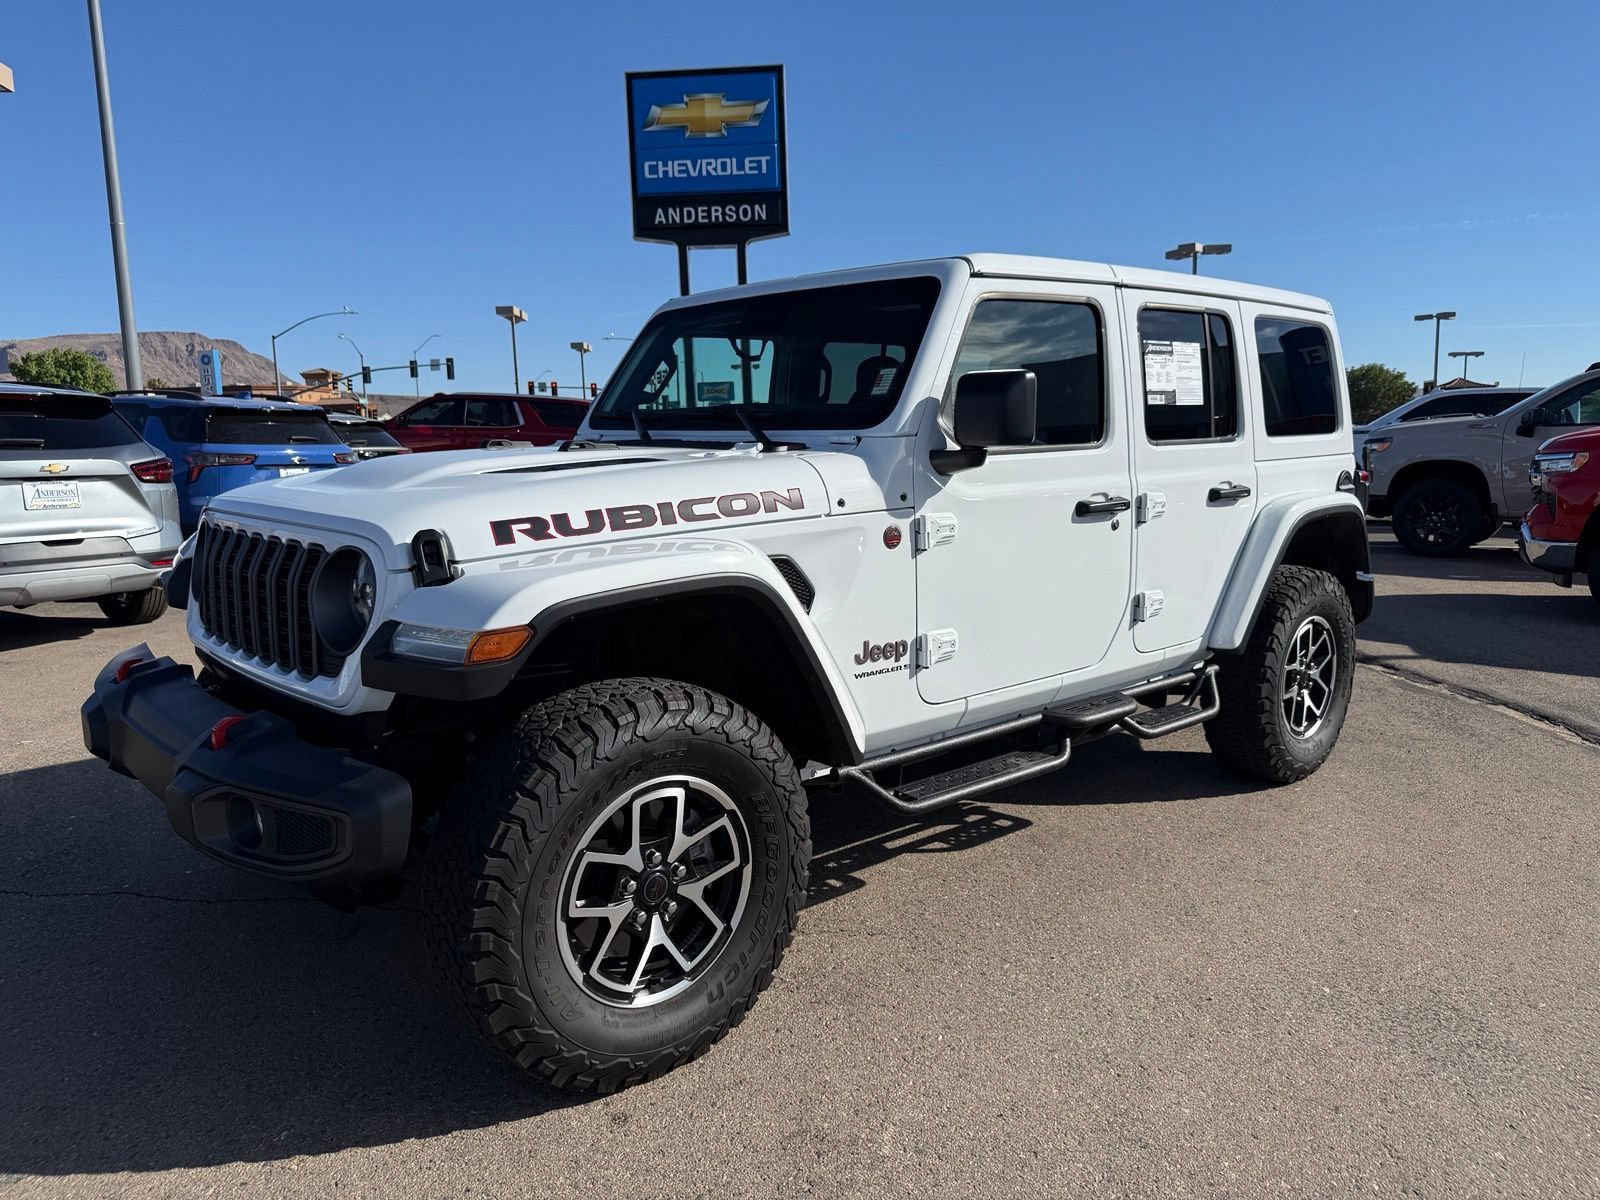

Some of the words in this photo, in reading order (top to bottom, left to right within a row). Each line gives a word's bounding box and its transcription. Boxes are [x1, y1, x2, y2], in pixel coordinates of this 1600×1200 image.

[644, 155, 770, 179] CHEVROLET
[654, 204, 767, 224] ANDERSON
[202, 367, 213, 394] ASE
[489, 488, 805, 546] RUBICON
[854, 640, 908, 665] Jeep
[854, 665, 902, 679] WRANGLER
[707, 792, 781, 1005] BFGoodrich
